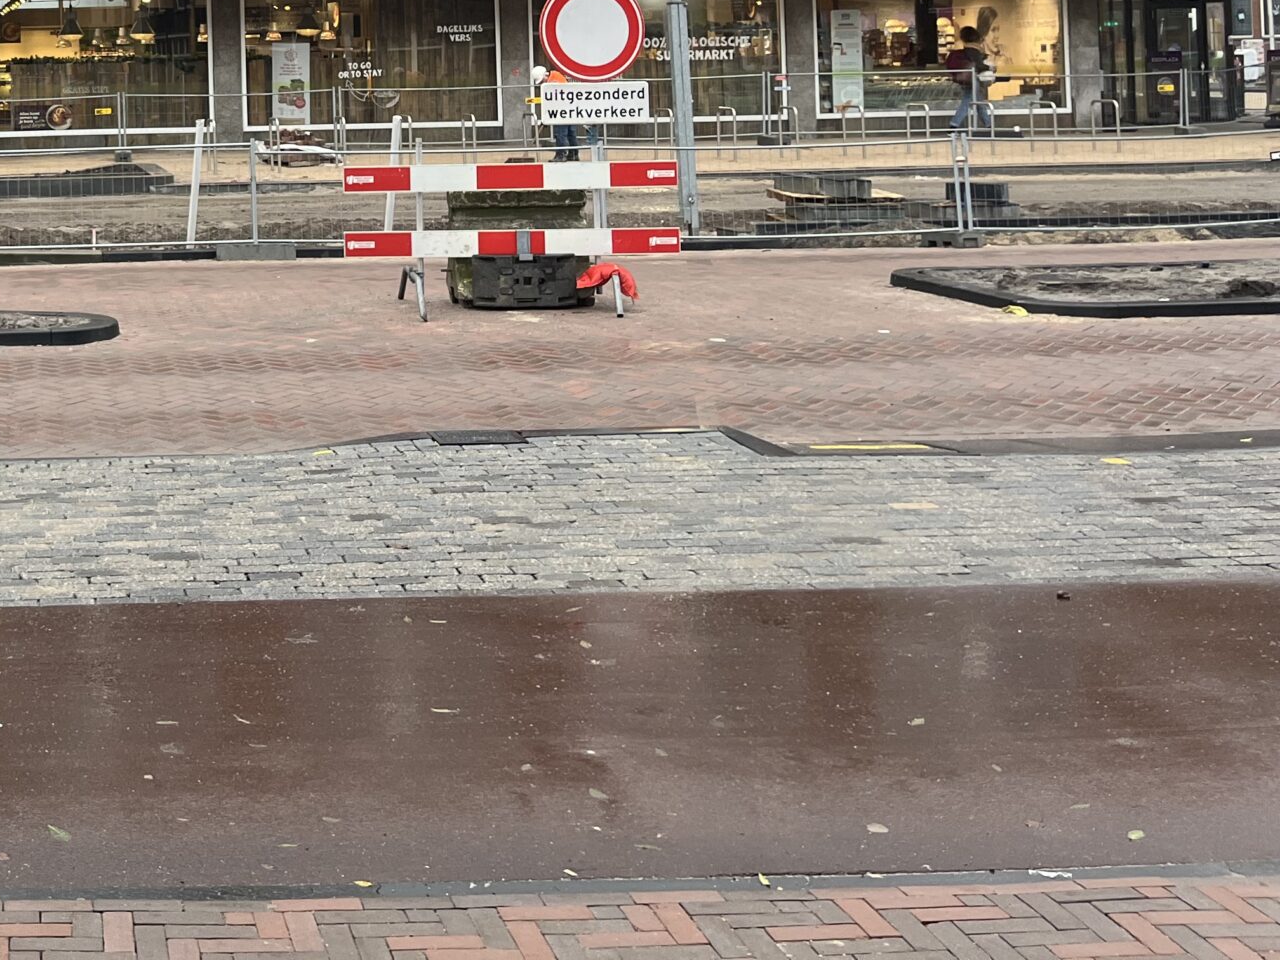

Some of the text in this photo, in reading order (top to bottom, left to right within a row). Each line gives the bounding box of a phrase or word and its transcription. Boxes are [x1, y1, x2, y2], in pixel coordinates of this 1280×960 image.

[437, 24, 483, 33] DAGELIJKS
[449, 34, 471, 42] VERS
[642, 35, 752, 49] 00% LOGISCHE
[656, 48, 735, 61] SURMARKT
[347, 61, 372, 70] TO GO
[338, 69, 383, 79] OR TO STAY
[544, 87, 645, 104] uitgezonderd
[547, 105, 644, 119] werkverkeer
